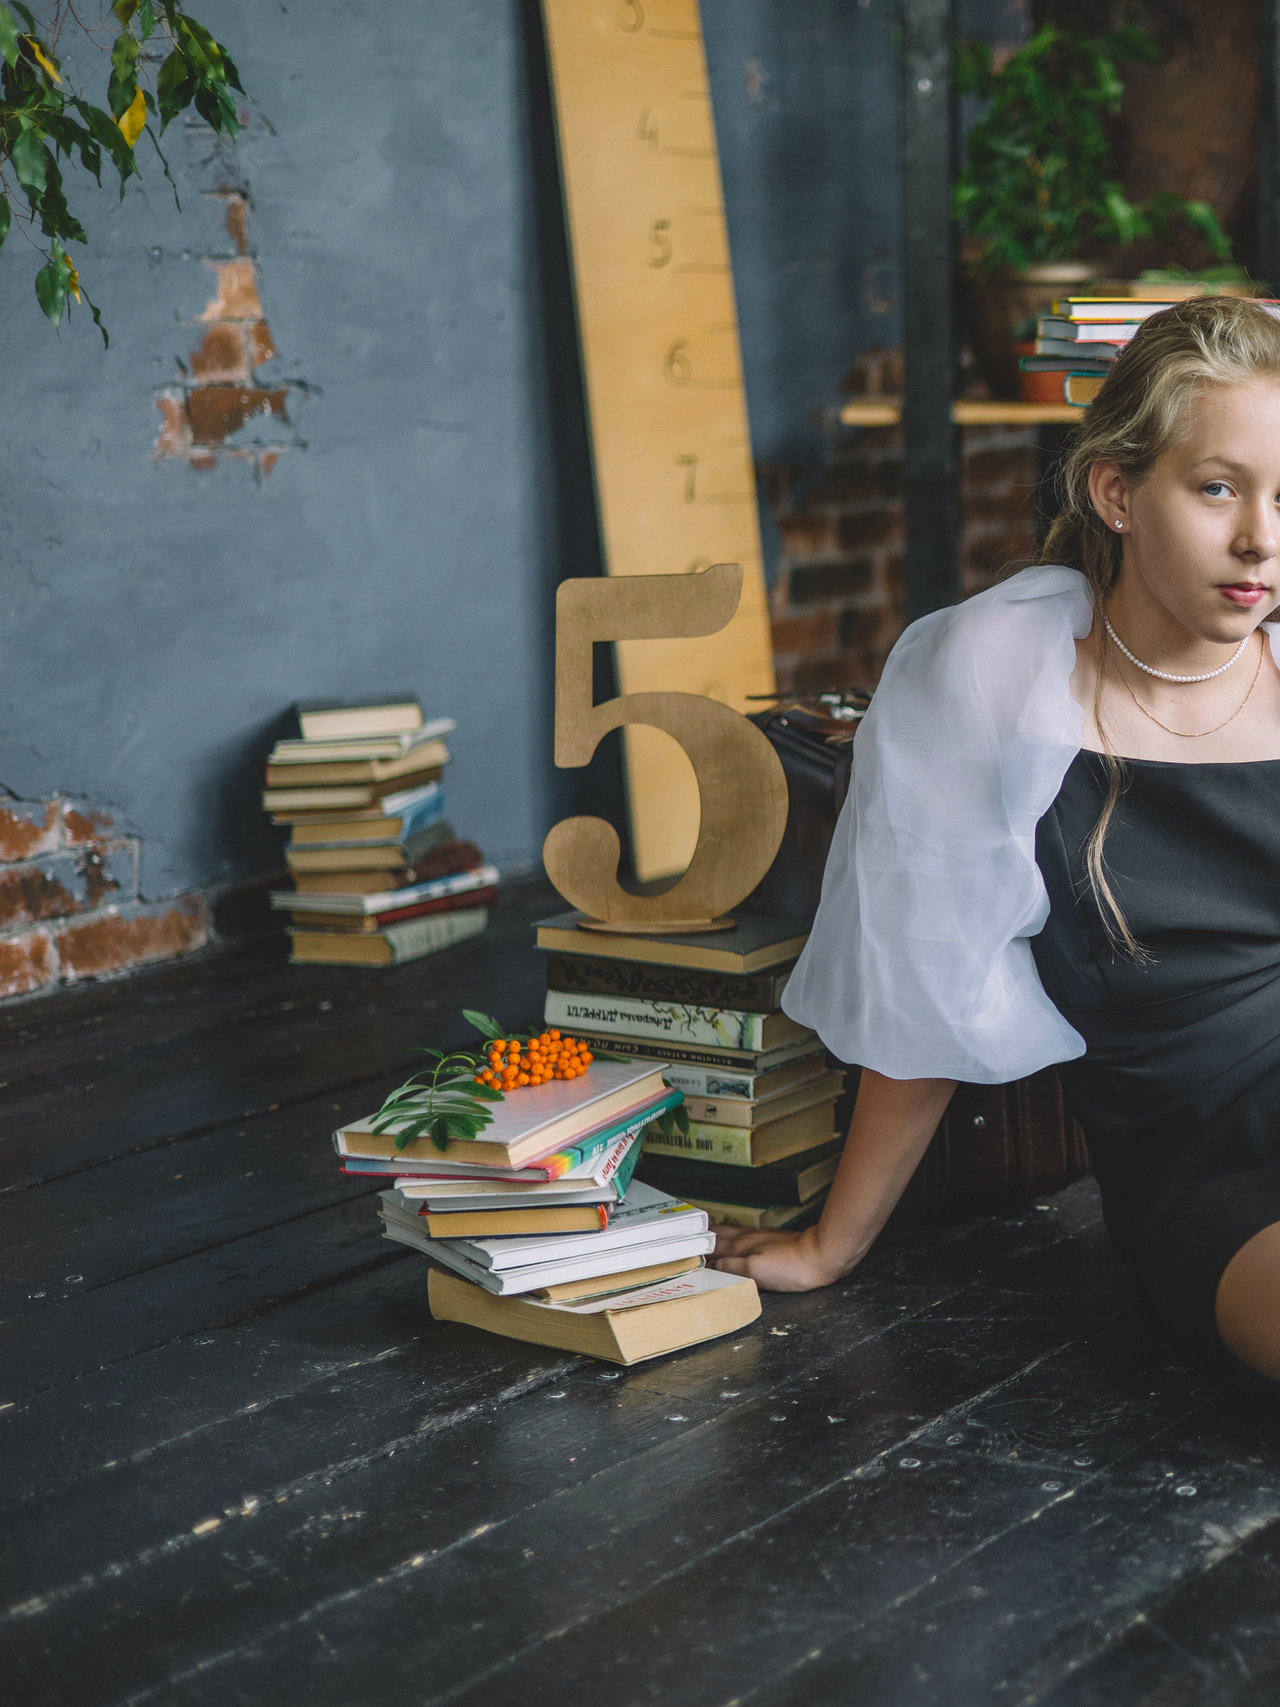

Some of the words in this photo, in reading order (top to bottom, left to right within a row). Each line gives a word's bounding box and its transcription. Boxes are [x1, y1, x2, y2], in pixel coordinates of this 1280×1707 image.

[635, 105, 661, 153] 4
[646, 217, 674, 270] 5
[662, 338, 693, 389] 6
[674, 452, 698, 504] 7
[542, 563, 789, 921] 5
[656, 1049, 687, 1060] КАТАЕВ
